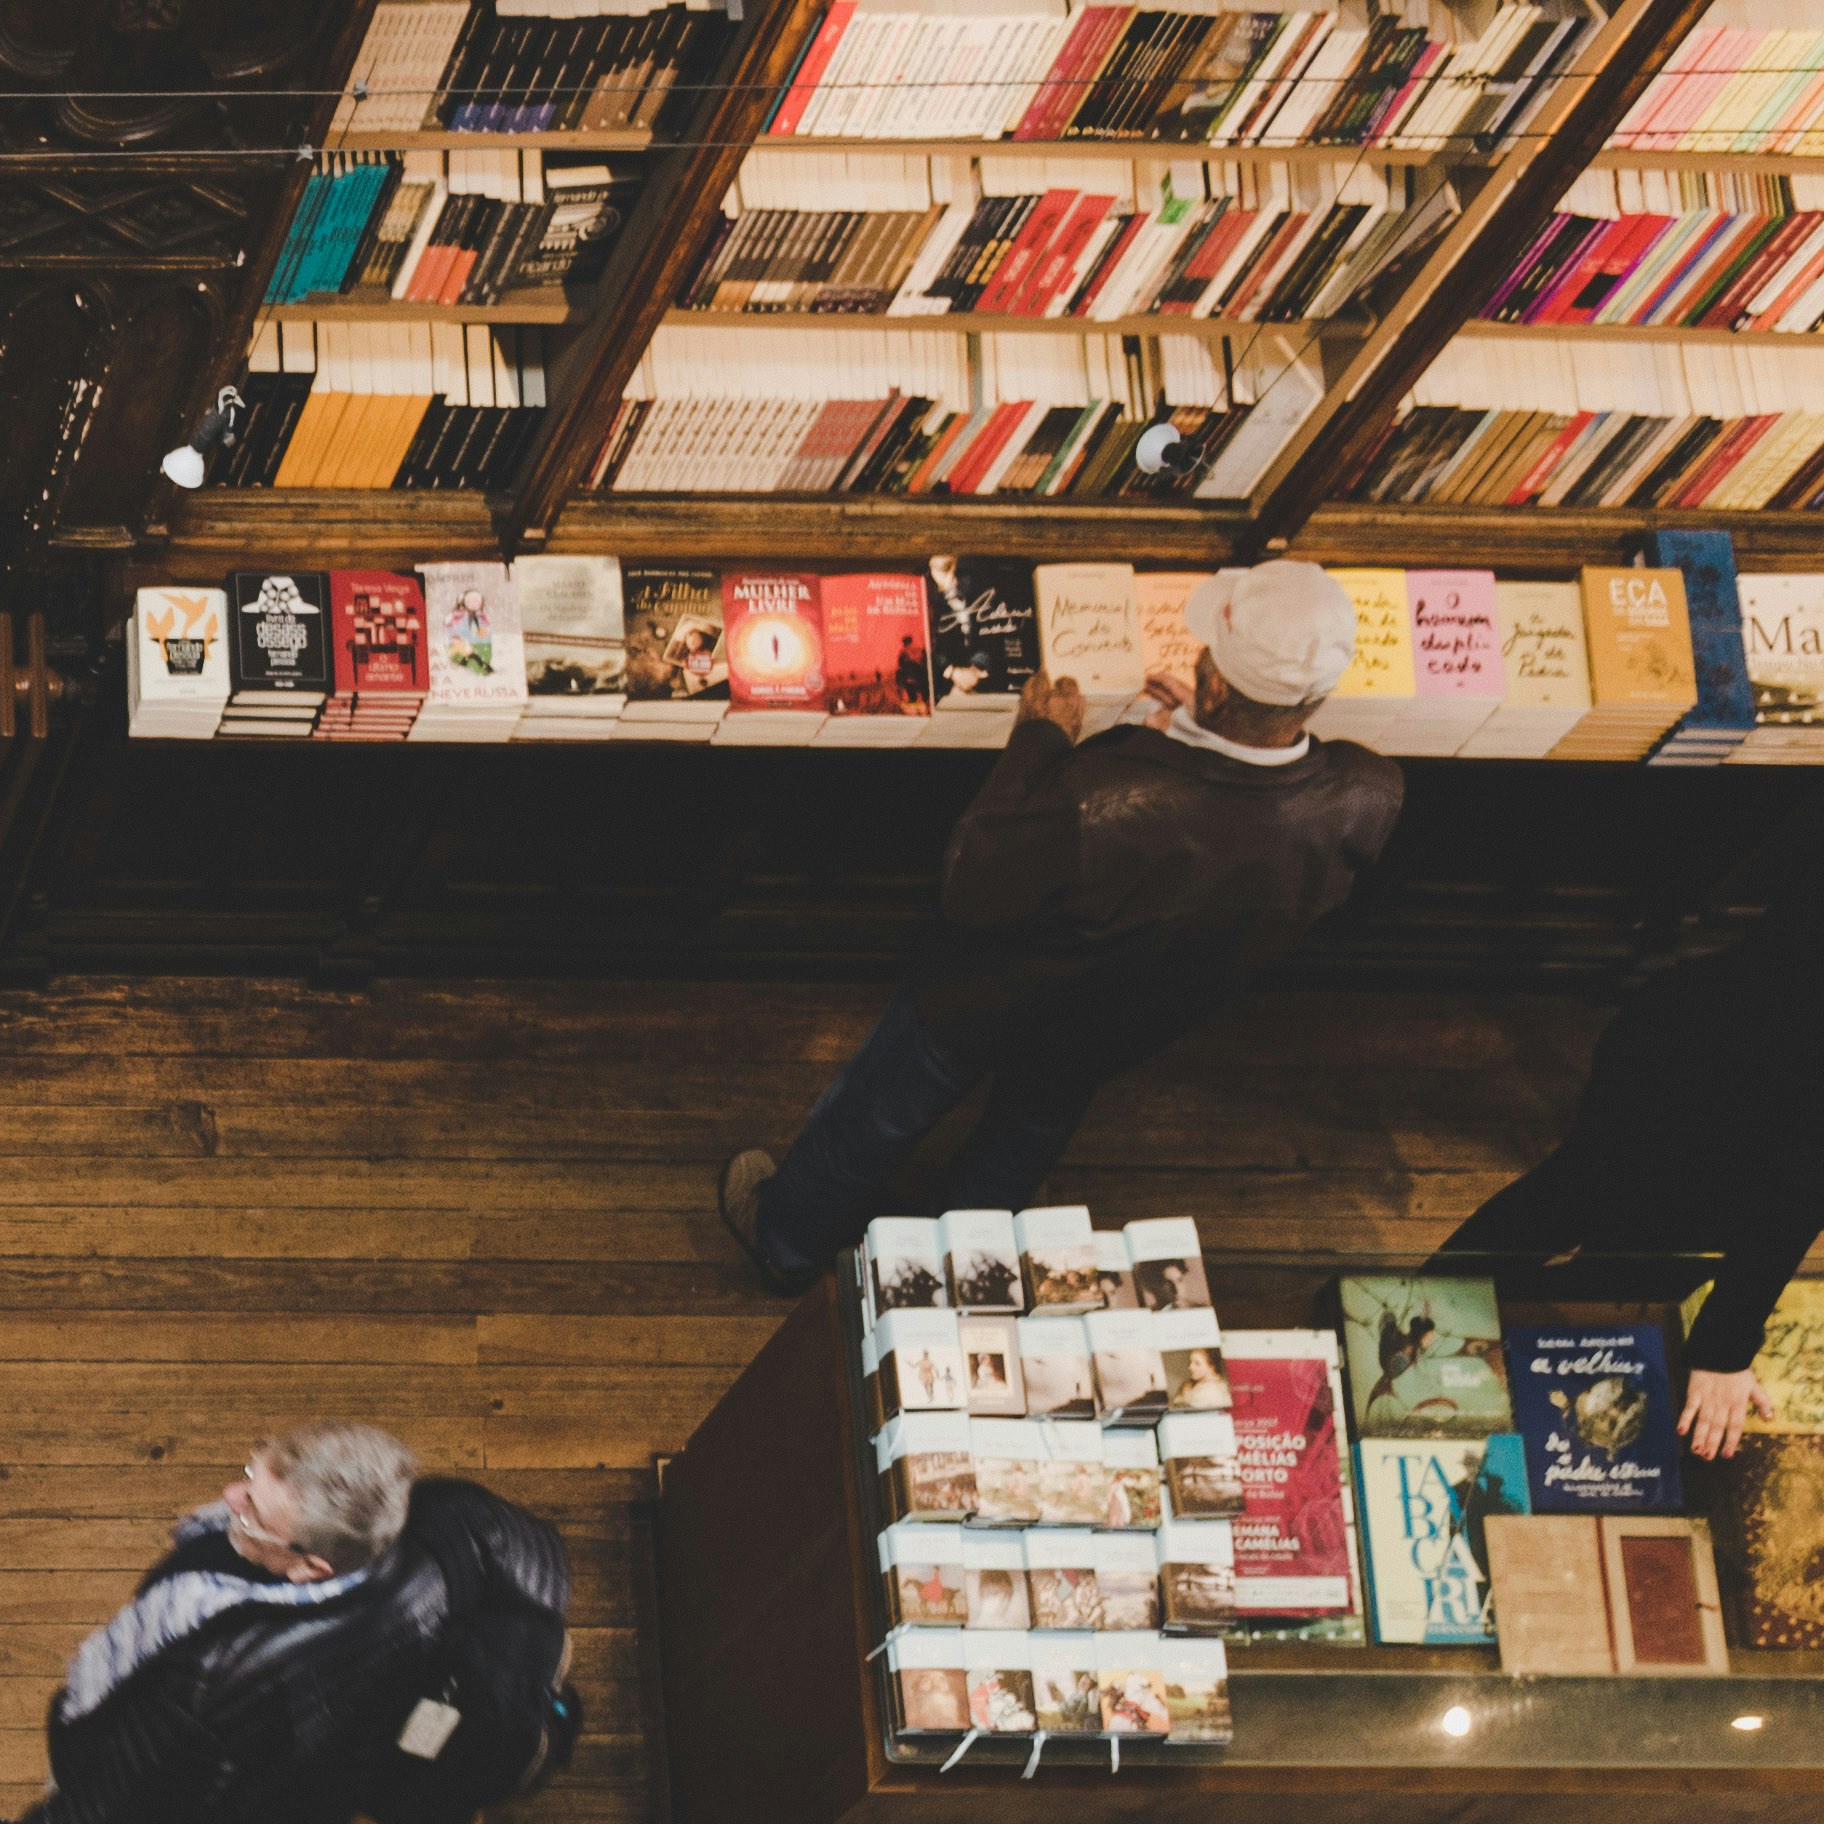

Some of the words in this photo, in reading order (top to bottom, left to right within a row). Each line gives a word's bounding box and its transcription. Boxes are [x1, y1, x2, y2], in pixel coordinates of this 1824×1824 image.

[733, 585, 811, 600] MULHER
[748, 599, 797, 613] LIVRE
[1241, 1468, 1289, 1484] ORTO
